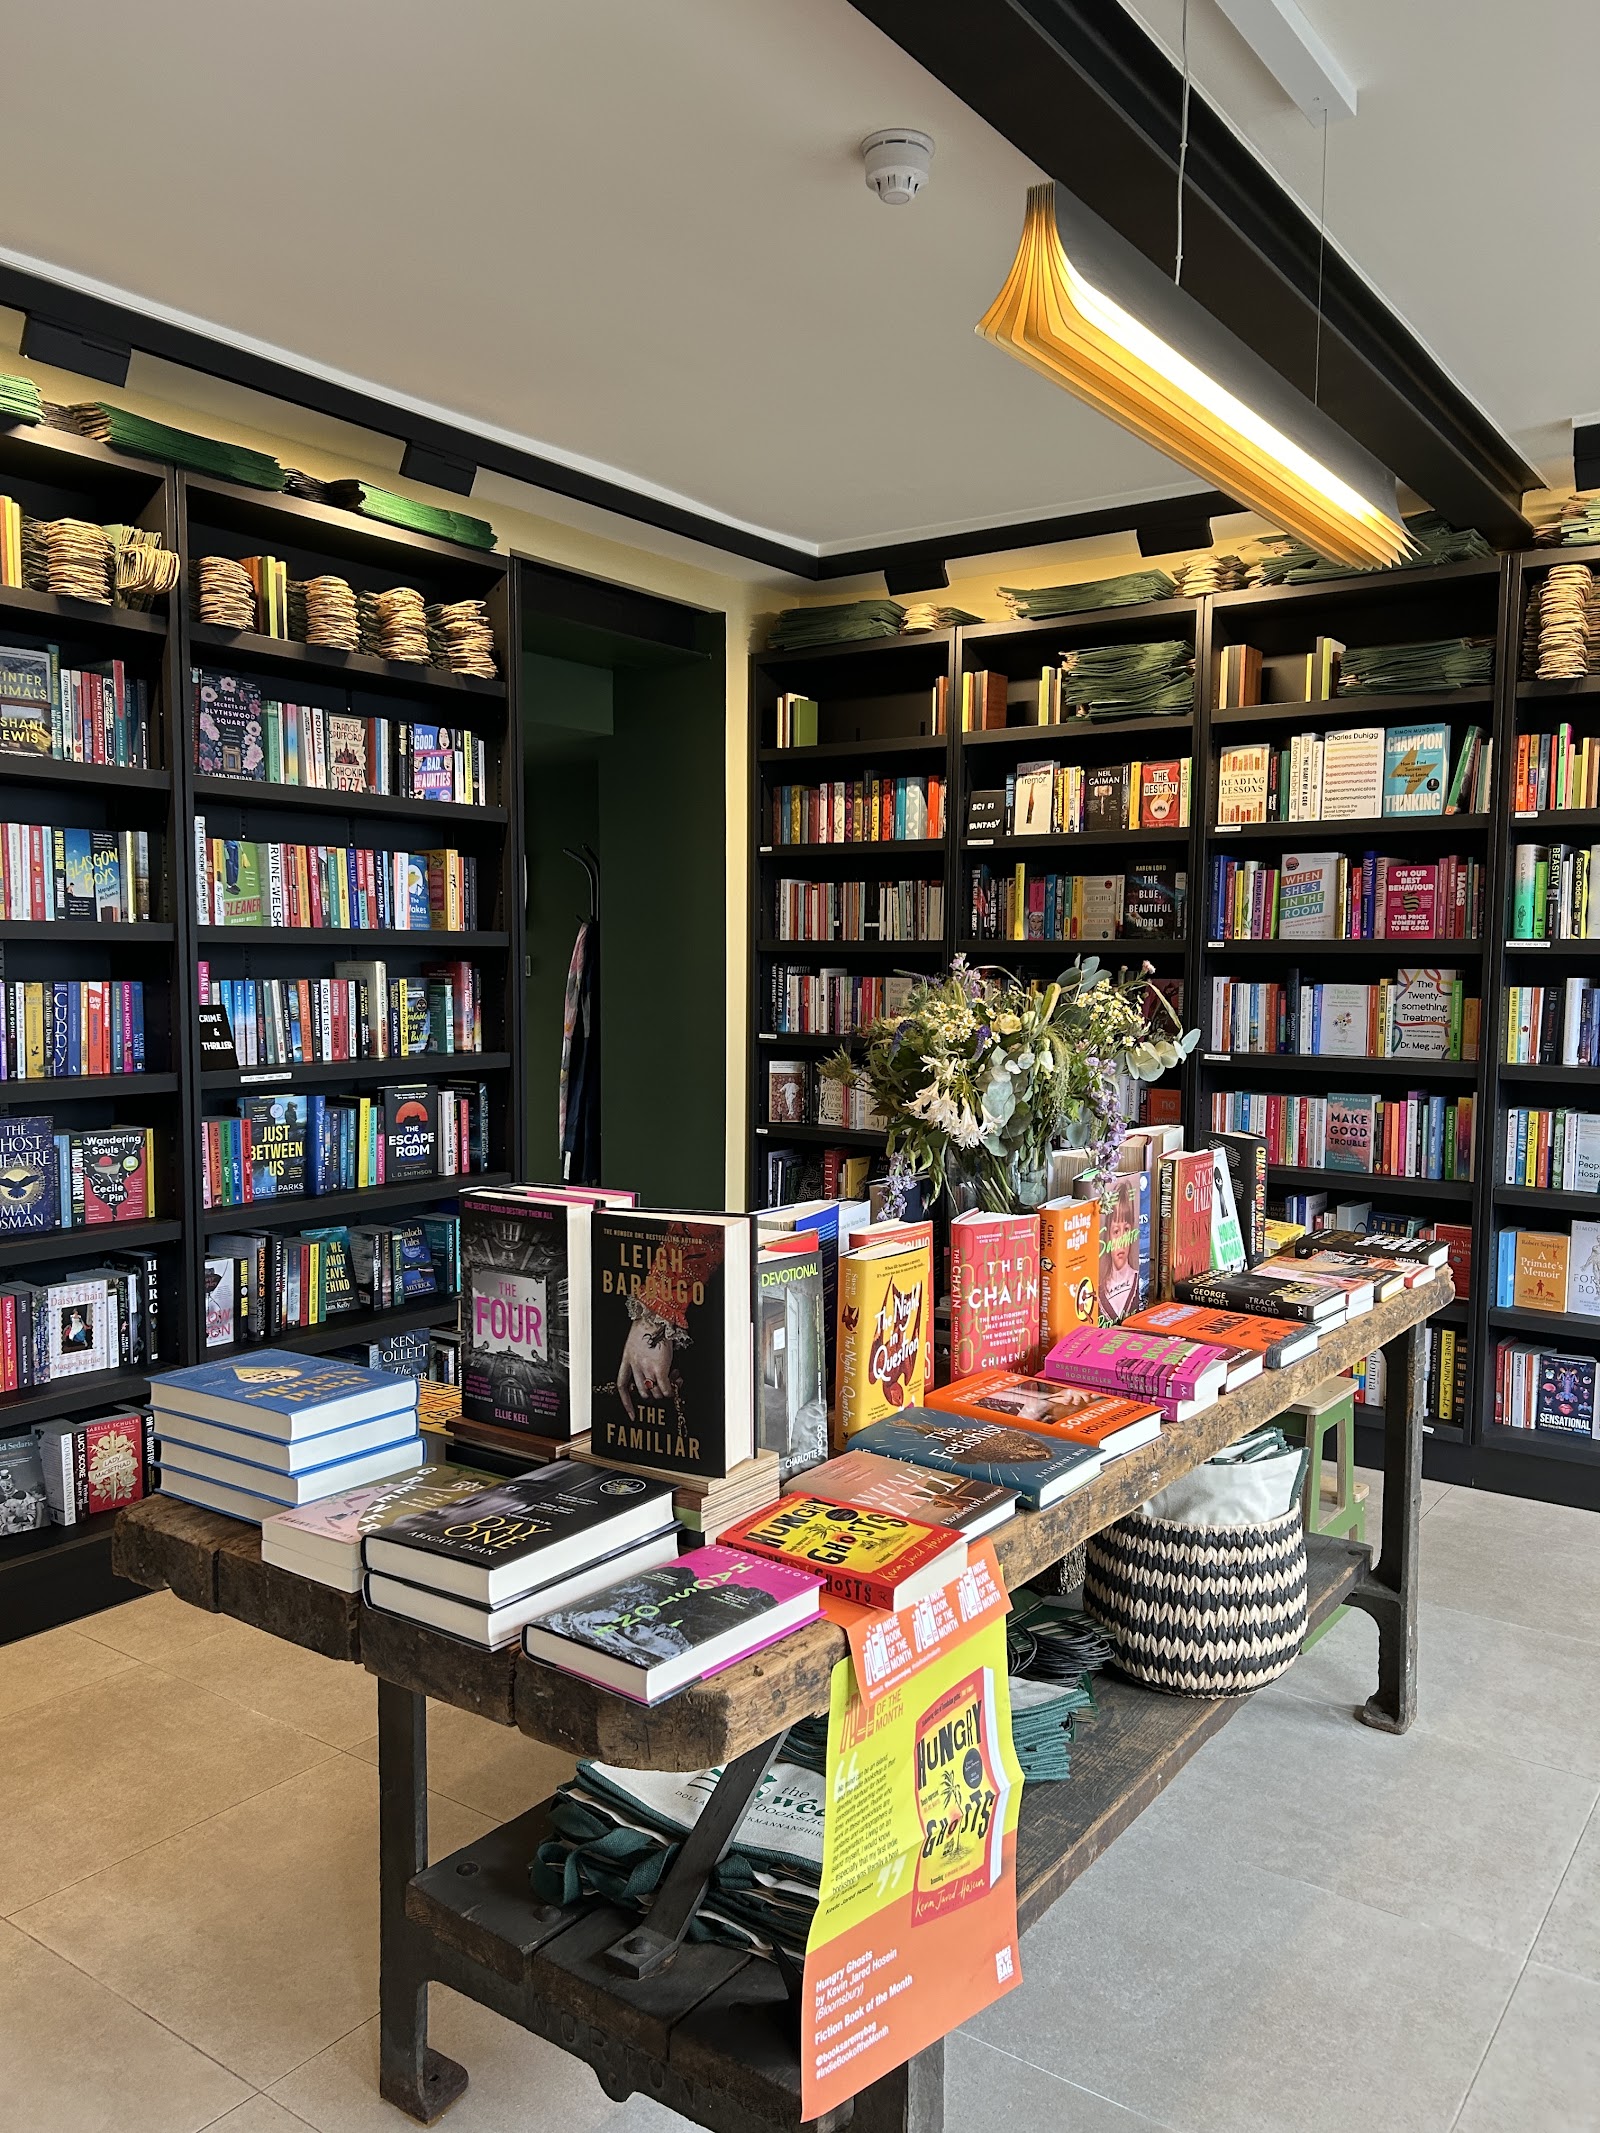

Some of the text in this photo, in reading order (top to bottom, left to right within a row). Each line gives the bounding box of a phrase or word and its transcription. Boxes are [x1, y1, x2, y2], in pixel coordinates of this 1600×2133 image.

[205, 707, 256, 720] BLYTHSWOOD
[213, 701, 238, 710] SECRETS
[216, 717, 245, 727] SQUARE
[333, 723, 358, 733] FRANCIS
[330, 731, 362, 741] SPUFFORD
[415, 737, 435, 750] GOOD,
[1328, 732, 1379, 741] Charles Duhigg
[1387, 732, 1443, 752] CHAMPION
[332, 767, 363, 778] CAHOKIA
[427, 761, 441, 771] BAD,
[338, 777, 360, 792] JAZZ
[423, 772, 450, 788] AUNTIES
[1089, 776, 1120, 785] GAIMAN
[1154, 772, 1168, 781] THE
[1221, 777, 1264, 786] READING
[1144, 783, 1178, 794] DESCENT
[1222, 785, 1263, 794] LESSONS
[972, 803, 985, 811] SCI
[1384, 792, 1441, 812] THINKING
[969, 820, 1000, 830] FANTASY
[66, 848, 118, 878] GLASGOW
[1551, 848, 1560, 886] BEASTLY
[84, 868, 115, 891] BOYS
[1143, 876, 1158, 884] THE
[1286, 870, 1320, 885] WHEN
[1139, 890, 1162, 899] BLUE,
[1285, 883, 1317, 896] SHE'S
[1388, 883, 1434, 891] BEHAVIOUR
[1286, 892, 1323, 906] IN THE
[1129, 904, 1172, 913] BEAUTIFUL
[1285, 905, 1320, 919] ROOM
[1136, 918, 1164, 927] WORLD
[1417, 981, 1433, 989] The
[1407, 992, 1442, 1002] Twenty-
[1402, 1003, 1447, 1012] something
[199, 1014, 222, 1022] CRIME
[1402, 1013, 1446, 1023] Treatment
[214, 1028, 220, 1036] &
[202, 1041, 233, 1050] THRILLER
[1401, 1042, 1445, 1052] Dr. Meg Jay
[1331, 1113, 1367, 1124] MAKE
[87, 1135, 141, 1145] Wandering
[262, 1126, 290, 1142] JUST
[389, 1134, 434, 1145] ESCAPE
[1331, 1126, 1367, 1138] GOOD
[1330, 1137, 1367, 1148] TROUBLE
[92, 1147, 119, 1155] Souls
[251, 1142, 302, 1160] BETWEEN
[396, 1146, 430, 1157] ROOM
[269, 1160, 284, 1176] US
[93, 1184, 123, 1193] Cecile
[1162, 1162, 1172, 1218] STACEY HALLS
[110, 1194, 123, 1202] Pin
[1064, 1213, 1091, 1232] talking
[1067, 1231, 1088, 1250] night
[1218, 1222, 1237, 1243] HOUSE
[620, 1243, 683, 1272] LEIGH
[1220, 1242, 1242, 1266] WOMAN
[1538, 1251, 1546, 1260] A
[987, 1257, 1023, 1274] THE
[1520, 1258, 1563, 1269] Primate's
[762, 1263, 818, 1287] DEVOTIONAL
[1523, 1267, 1560, 1279] Memoir
[498, 1282, 517, 1297] THE
[602, 1271, 704, 1305] BARDUGO
[968, 1279, 1038, 1309] CHAIN
[1192, 1288, 1226, 1299] GEORGE
[894, 1286, 919, 1325] Night
[1208, 1298, 1229, 1307] POET
[1244, 1304, 1279, 1314] RECORD
[1248, 1296, 1276, 1307] TRACK
[476, 1296, 542, 1346] FOUR
[875, 1307, 892, 1333] The
[1205, 1314, 1249, 1334] JAMES
[390, 1335, 414, 1348] KEN
[890, 1333, 897, 1348] in
[873, 1340, 919, 1381] Question
[982, 1351, 1026, 1367] CHIMENE
[953, 1375, 1022, 1403] THE START OF
[495, 1408, 529, 1424] ELLIE KEEL
[638, 1405, 666, 1425] THE
[1060, 1399, 1127, 1429] SOMETHING
[1540, 1413, 1591, 1430] SENSATIONAL
[924, 1424, 961, 1441] The
[1083, 1421, 1107, 1435] HOLLY
[607, 1424, 700, 1459] FAMILIAR
[929, 1423, 1007, 1461] Fetishist
[785, 1451, 817, 1469] CHARLOTTE
[850, 1466, 931, 1506] WHALE
[358, 1468, 437, 1532] GREENER
[879, 1475, 964, 1516] FALL
[471, 1516, 552, 1538] DAY
[743, 1498, 839, 1549] HUNGRY
[407, 1531, 497, 1556] ABIGAIL DEAN
[444, 1524, 527, 1550] ONE
[807, 1514, 909, 1565] GHOSTS
[705, 1546, 810, 1581] SINEAD GLEESON
[594, 1562, 754, 1638] HAGSTONE
[882, 1615, 899, 1632] INDIE
[886, 1629, 902, 1644] BOOK
[888, 1640, 908, 1660] OF THE
[890, 1648, 912, 1669] MONTH
[876, 1689, 902, 1716] OF THE
[875, 1703, 904, 1733] MONTH
[916, 1700, 982, 1791] HUNGRY
[781, 1786, 810, 1799] the
[754, 1804, 824, 1825] booksho
[923, 1790, 996, 1859] GHOSTS
[816, 1950, 873, 1992] Hungry Ghosts
[816, 1949, 897, 2006] by Kevin Jared Hosein
[815, 1982, 864, 2023] (Bloomsbury)
[815, 1975, 912, 2044] Fiction Book of the Month
[816, 2021, 876, 2066] @booksaremybag
